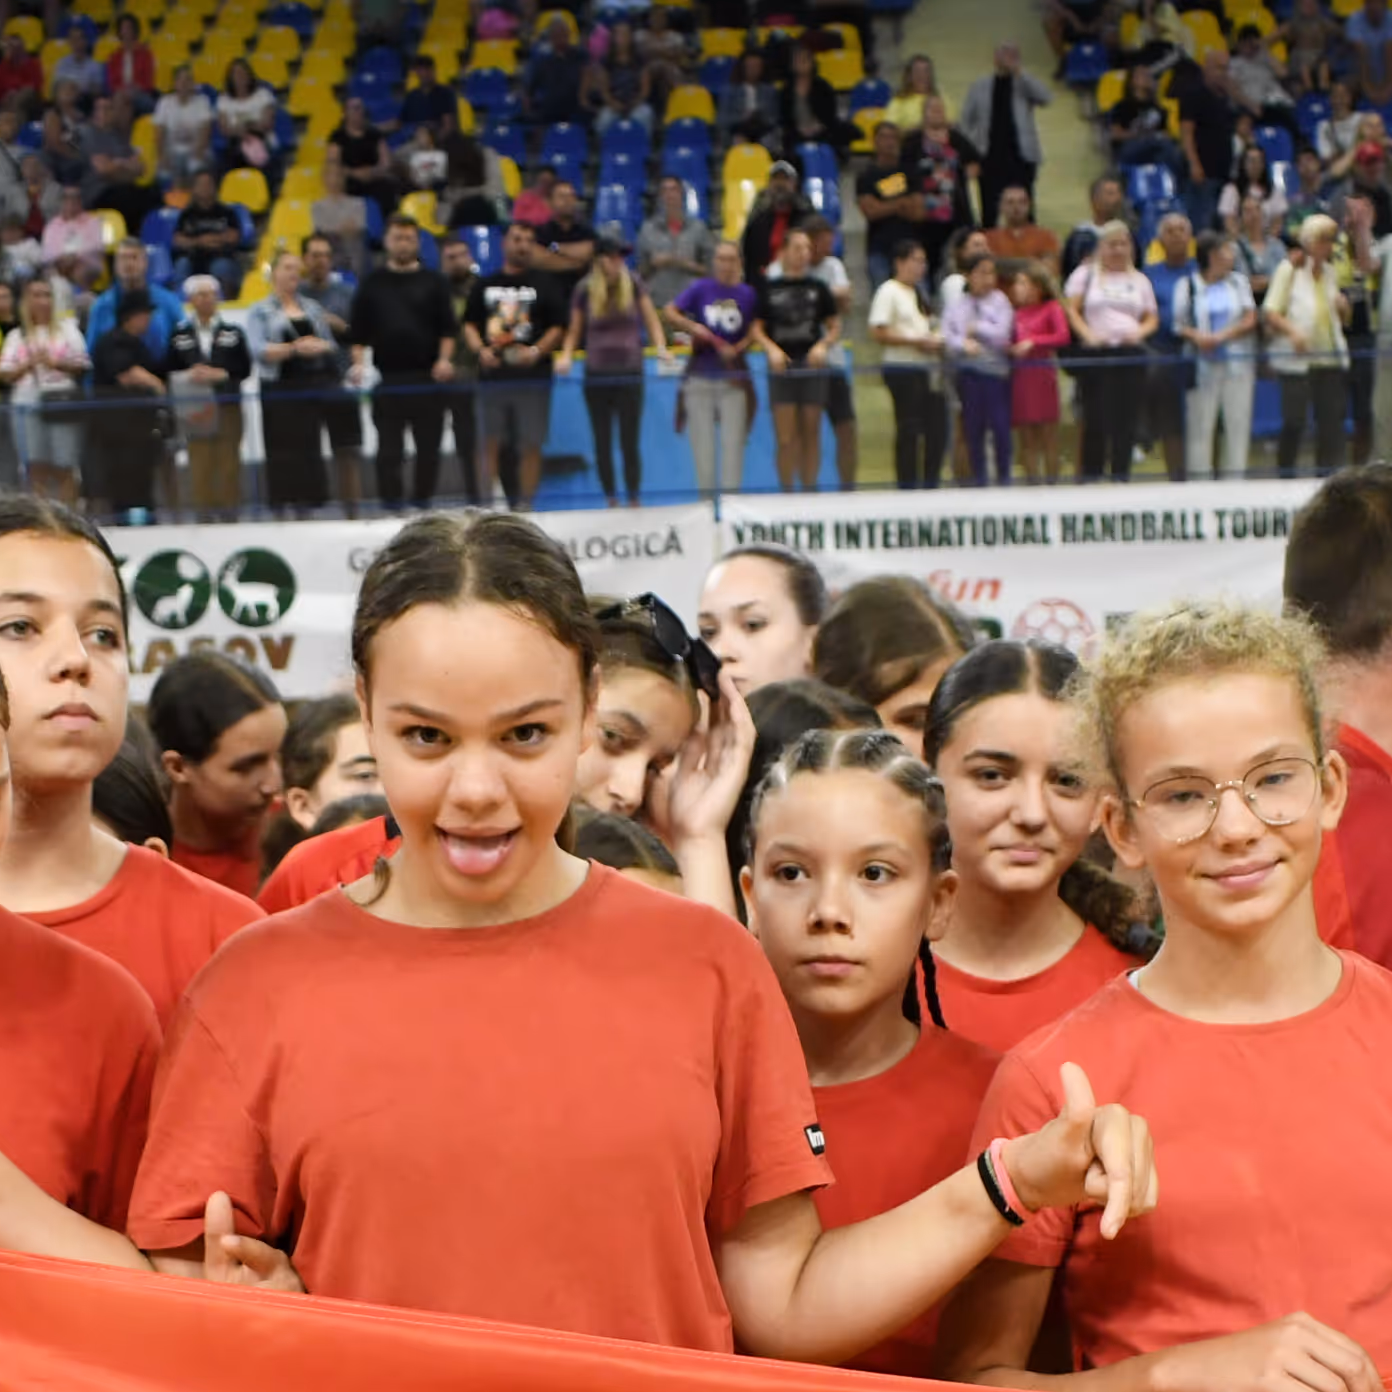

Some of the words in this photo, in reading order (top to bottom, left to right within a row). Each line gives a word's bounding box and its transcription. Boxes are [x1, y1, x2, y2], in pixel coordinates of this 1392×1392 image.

[732, 519, 825, 549] YOUTH
[834, 512, 1052, 549] INTERNATIONAL
[1060, 508, 1207, 544] HANDBALL
